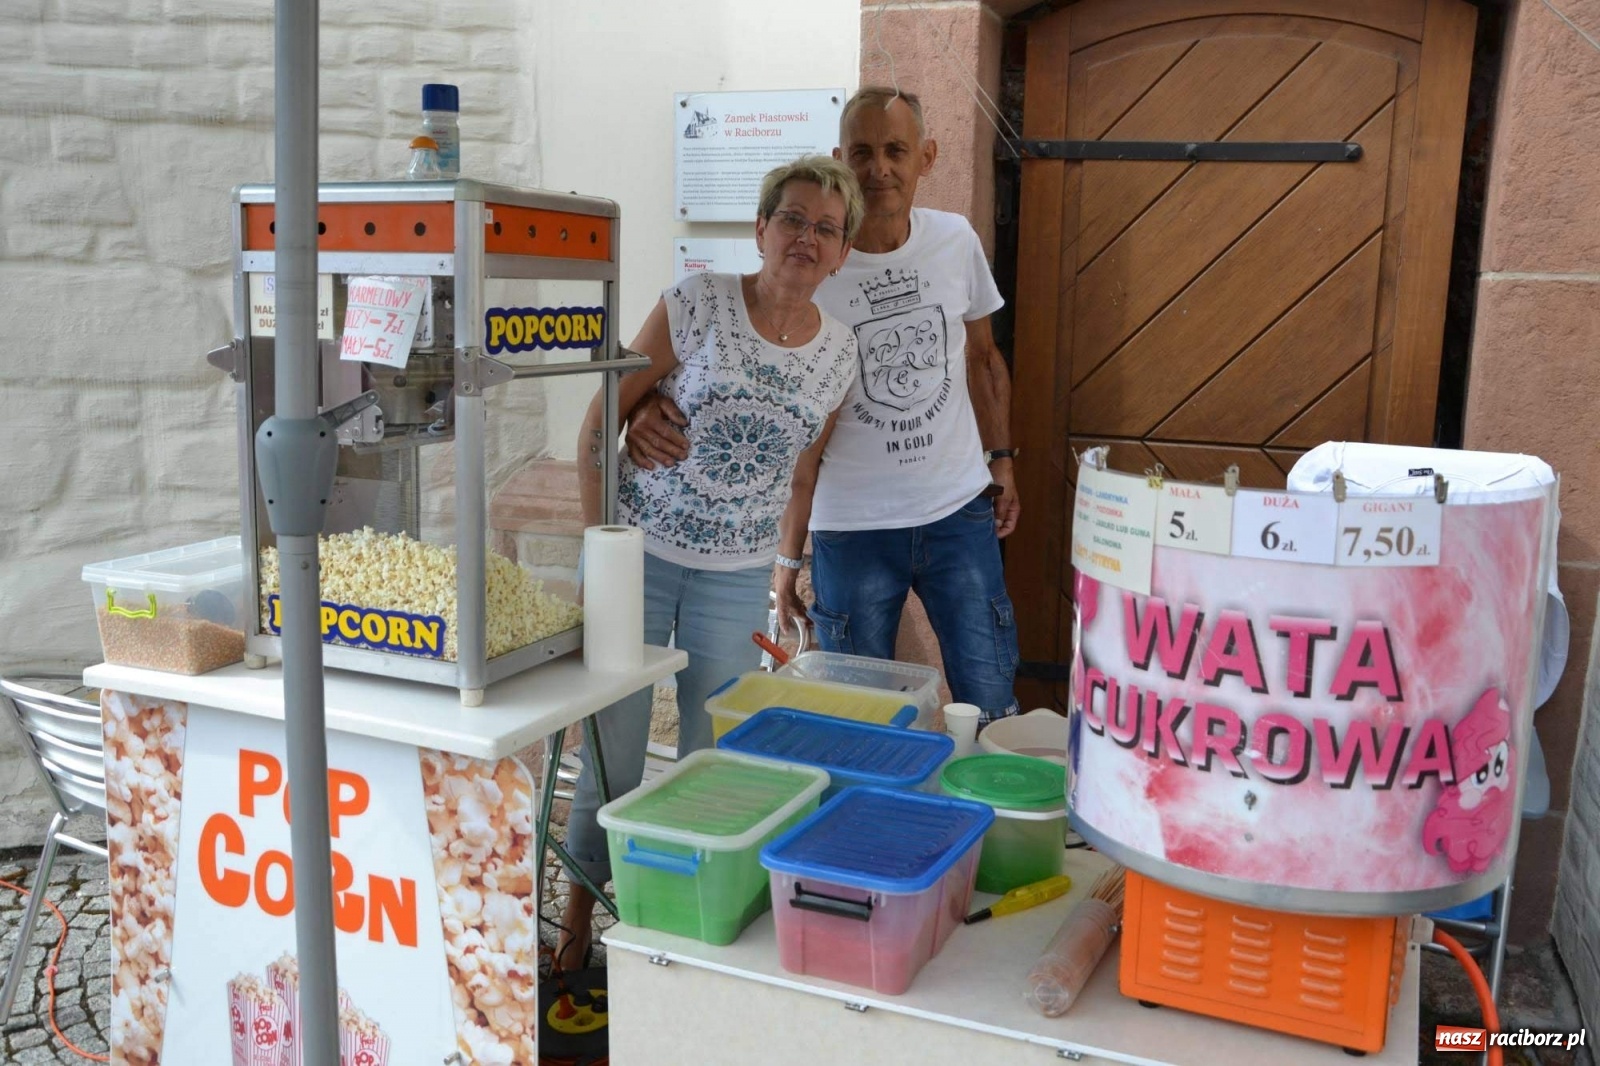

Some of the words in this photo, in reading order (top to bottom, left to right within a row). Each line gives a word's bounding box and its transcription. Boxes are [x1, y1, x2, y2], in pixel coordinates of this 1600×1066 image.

[724, 113, 756, 123] Zamek
[759, 112, 809, 123] Piastowski
[735, 127, 782, 137] Raciborzu
[254, 305, 276, 315] MAŁ
[259, 318, 278, 328] DU
[488, 313, 603, 346] POPCORN
[891, 416, 922, 432] YOUR
[886, 440, 900, 454] IN
[904, 433, 933, 450] GOLD
[1169, 487, 1201, 499] MAŁA
[1263, 495, 1300, 509] DUŻA
[1363, 502, 1414, 513] GIGANT
[1116, 525, 1128, 534] LUB
[1130, 527, 1151, 538] GUMA
[1343, 526, 1415, 562] 7,50
[272, 599, 440, 651] PCORN
[1121, 592, 1402, 701] WATA
[1084, 666, 1456, 790] CUKROWA
[238, 748, 371, 838] PP
[198, 811, 418, 948] CORN
[253, 1017, 272, 1033] POP
[255, 1030, 278, 1046] CORN
